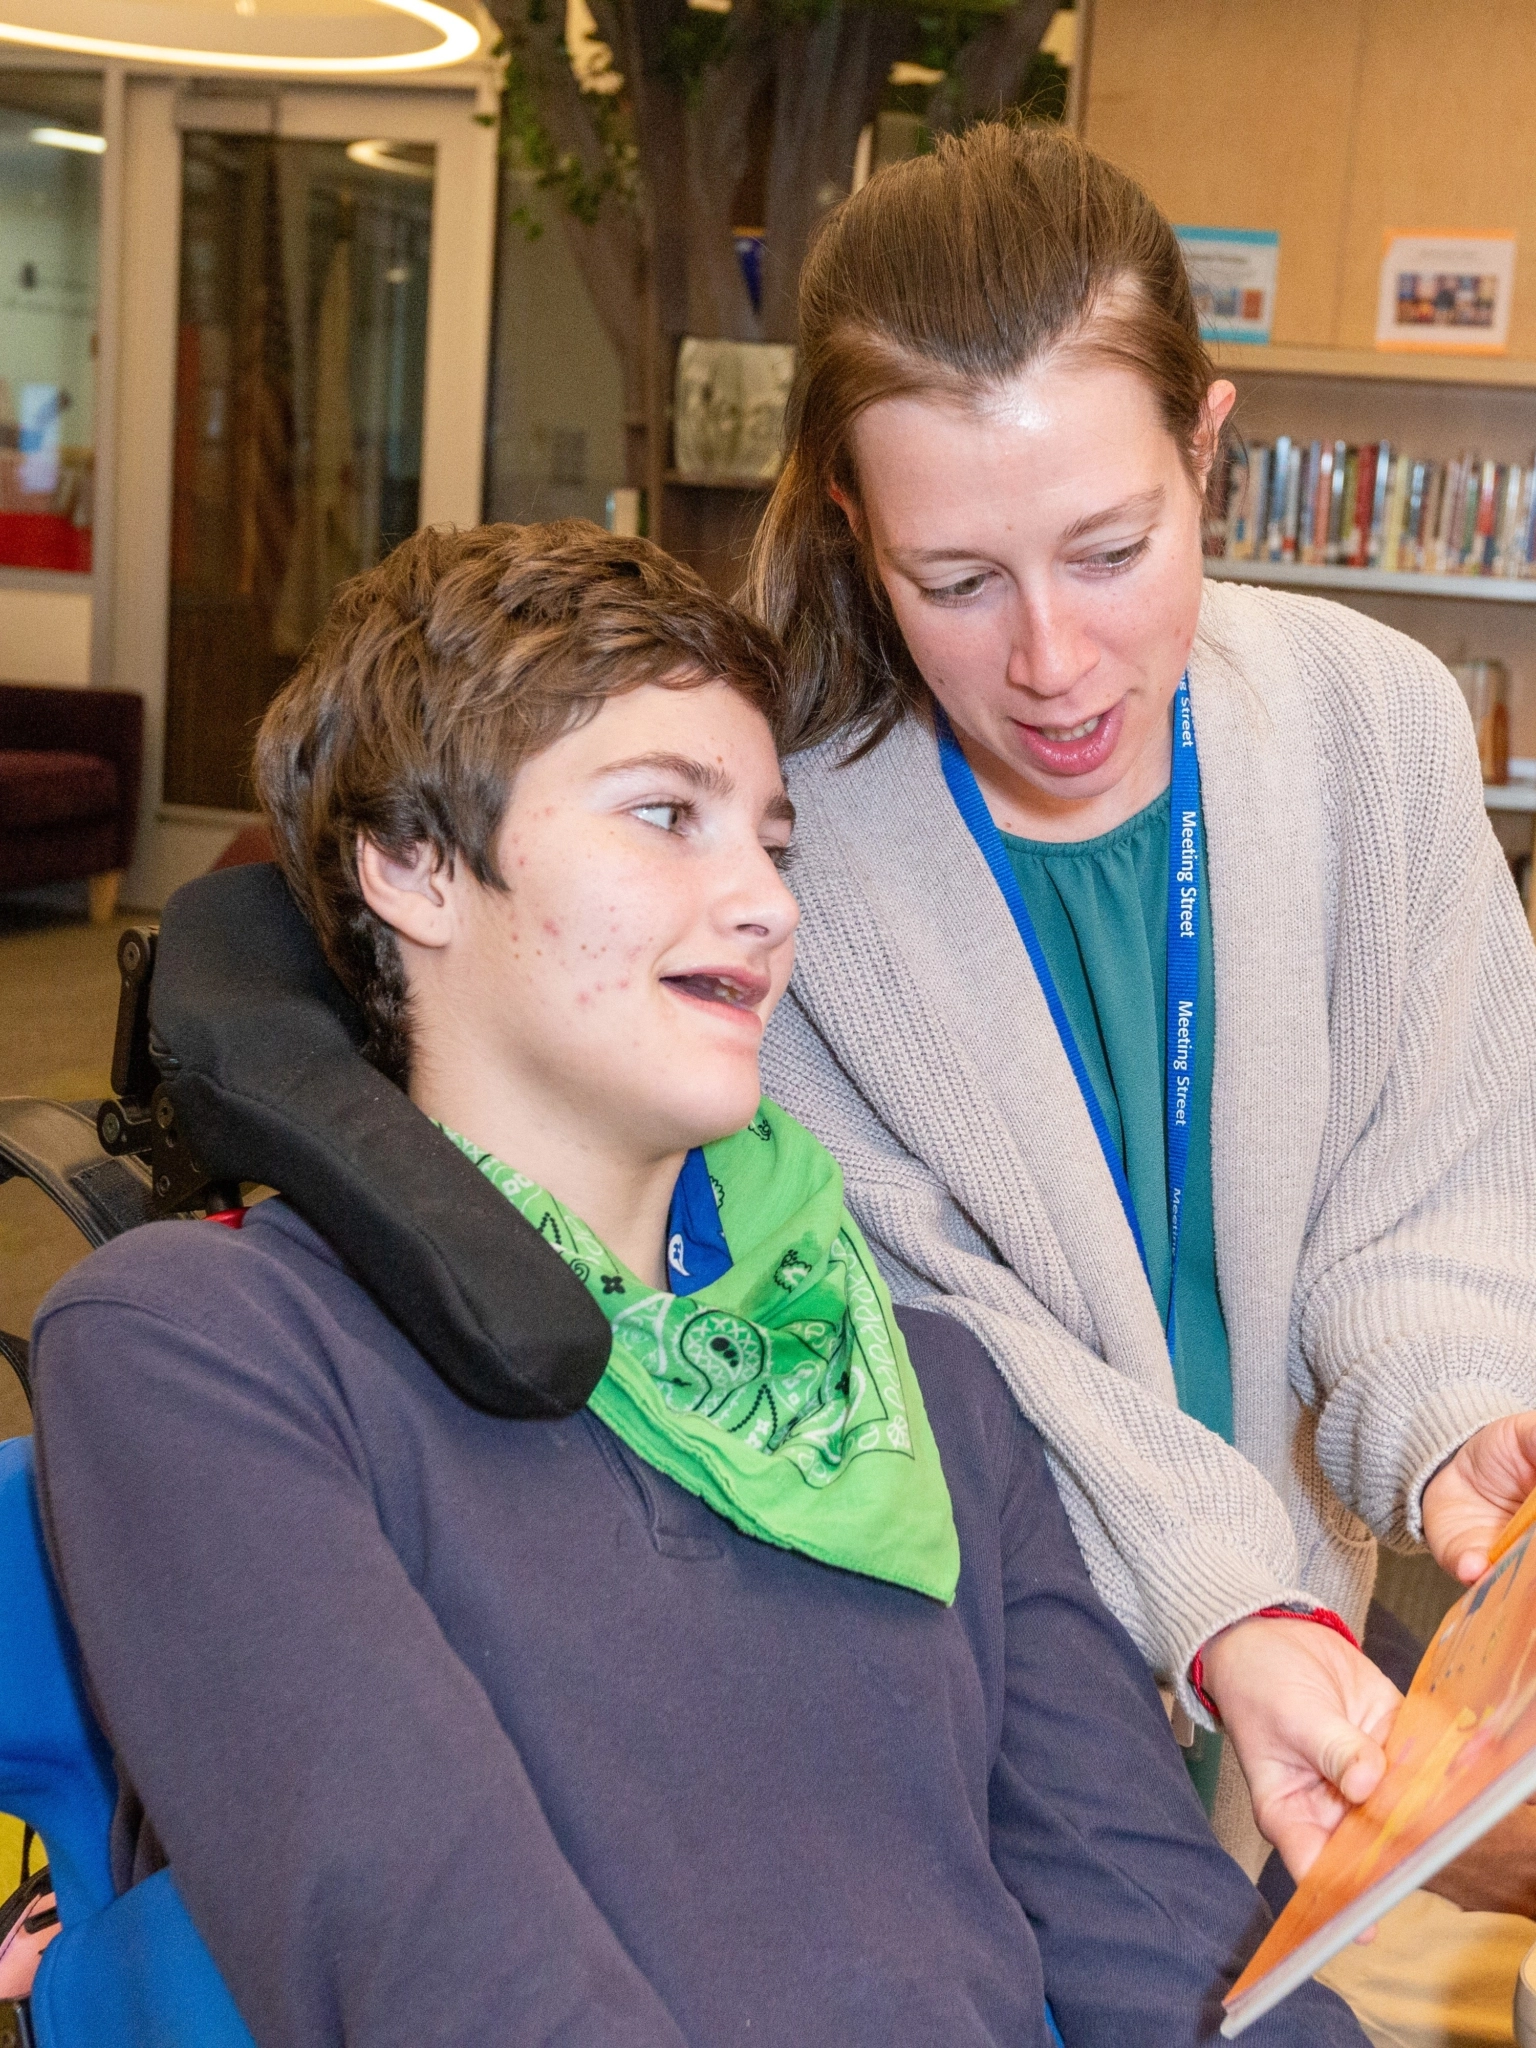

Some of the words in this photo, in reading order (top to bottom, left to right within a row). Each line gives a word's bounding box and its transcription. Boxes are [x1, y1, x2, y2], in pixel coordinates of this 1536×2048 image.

[1181, 697, 1194, 747] Street
[1176, 811, 1197, 882] Meeting
[1180, 887, 1197, 938] Street
[1173, 1000, 1193, 1071] Meeting
[1175, 1076, 1190, 1127] Street
